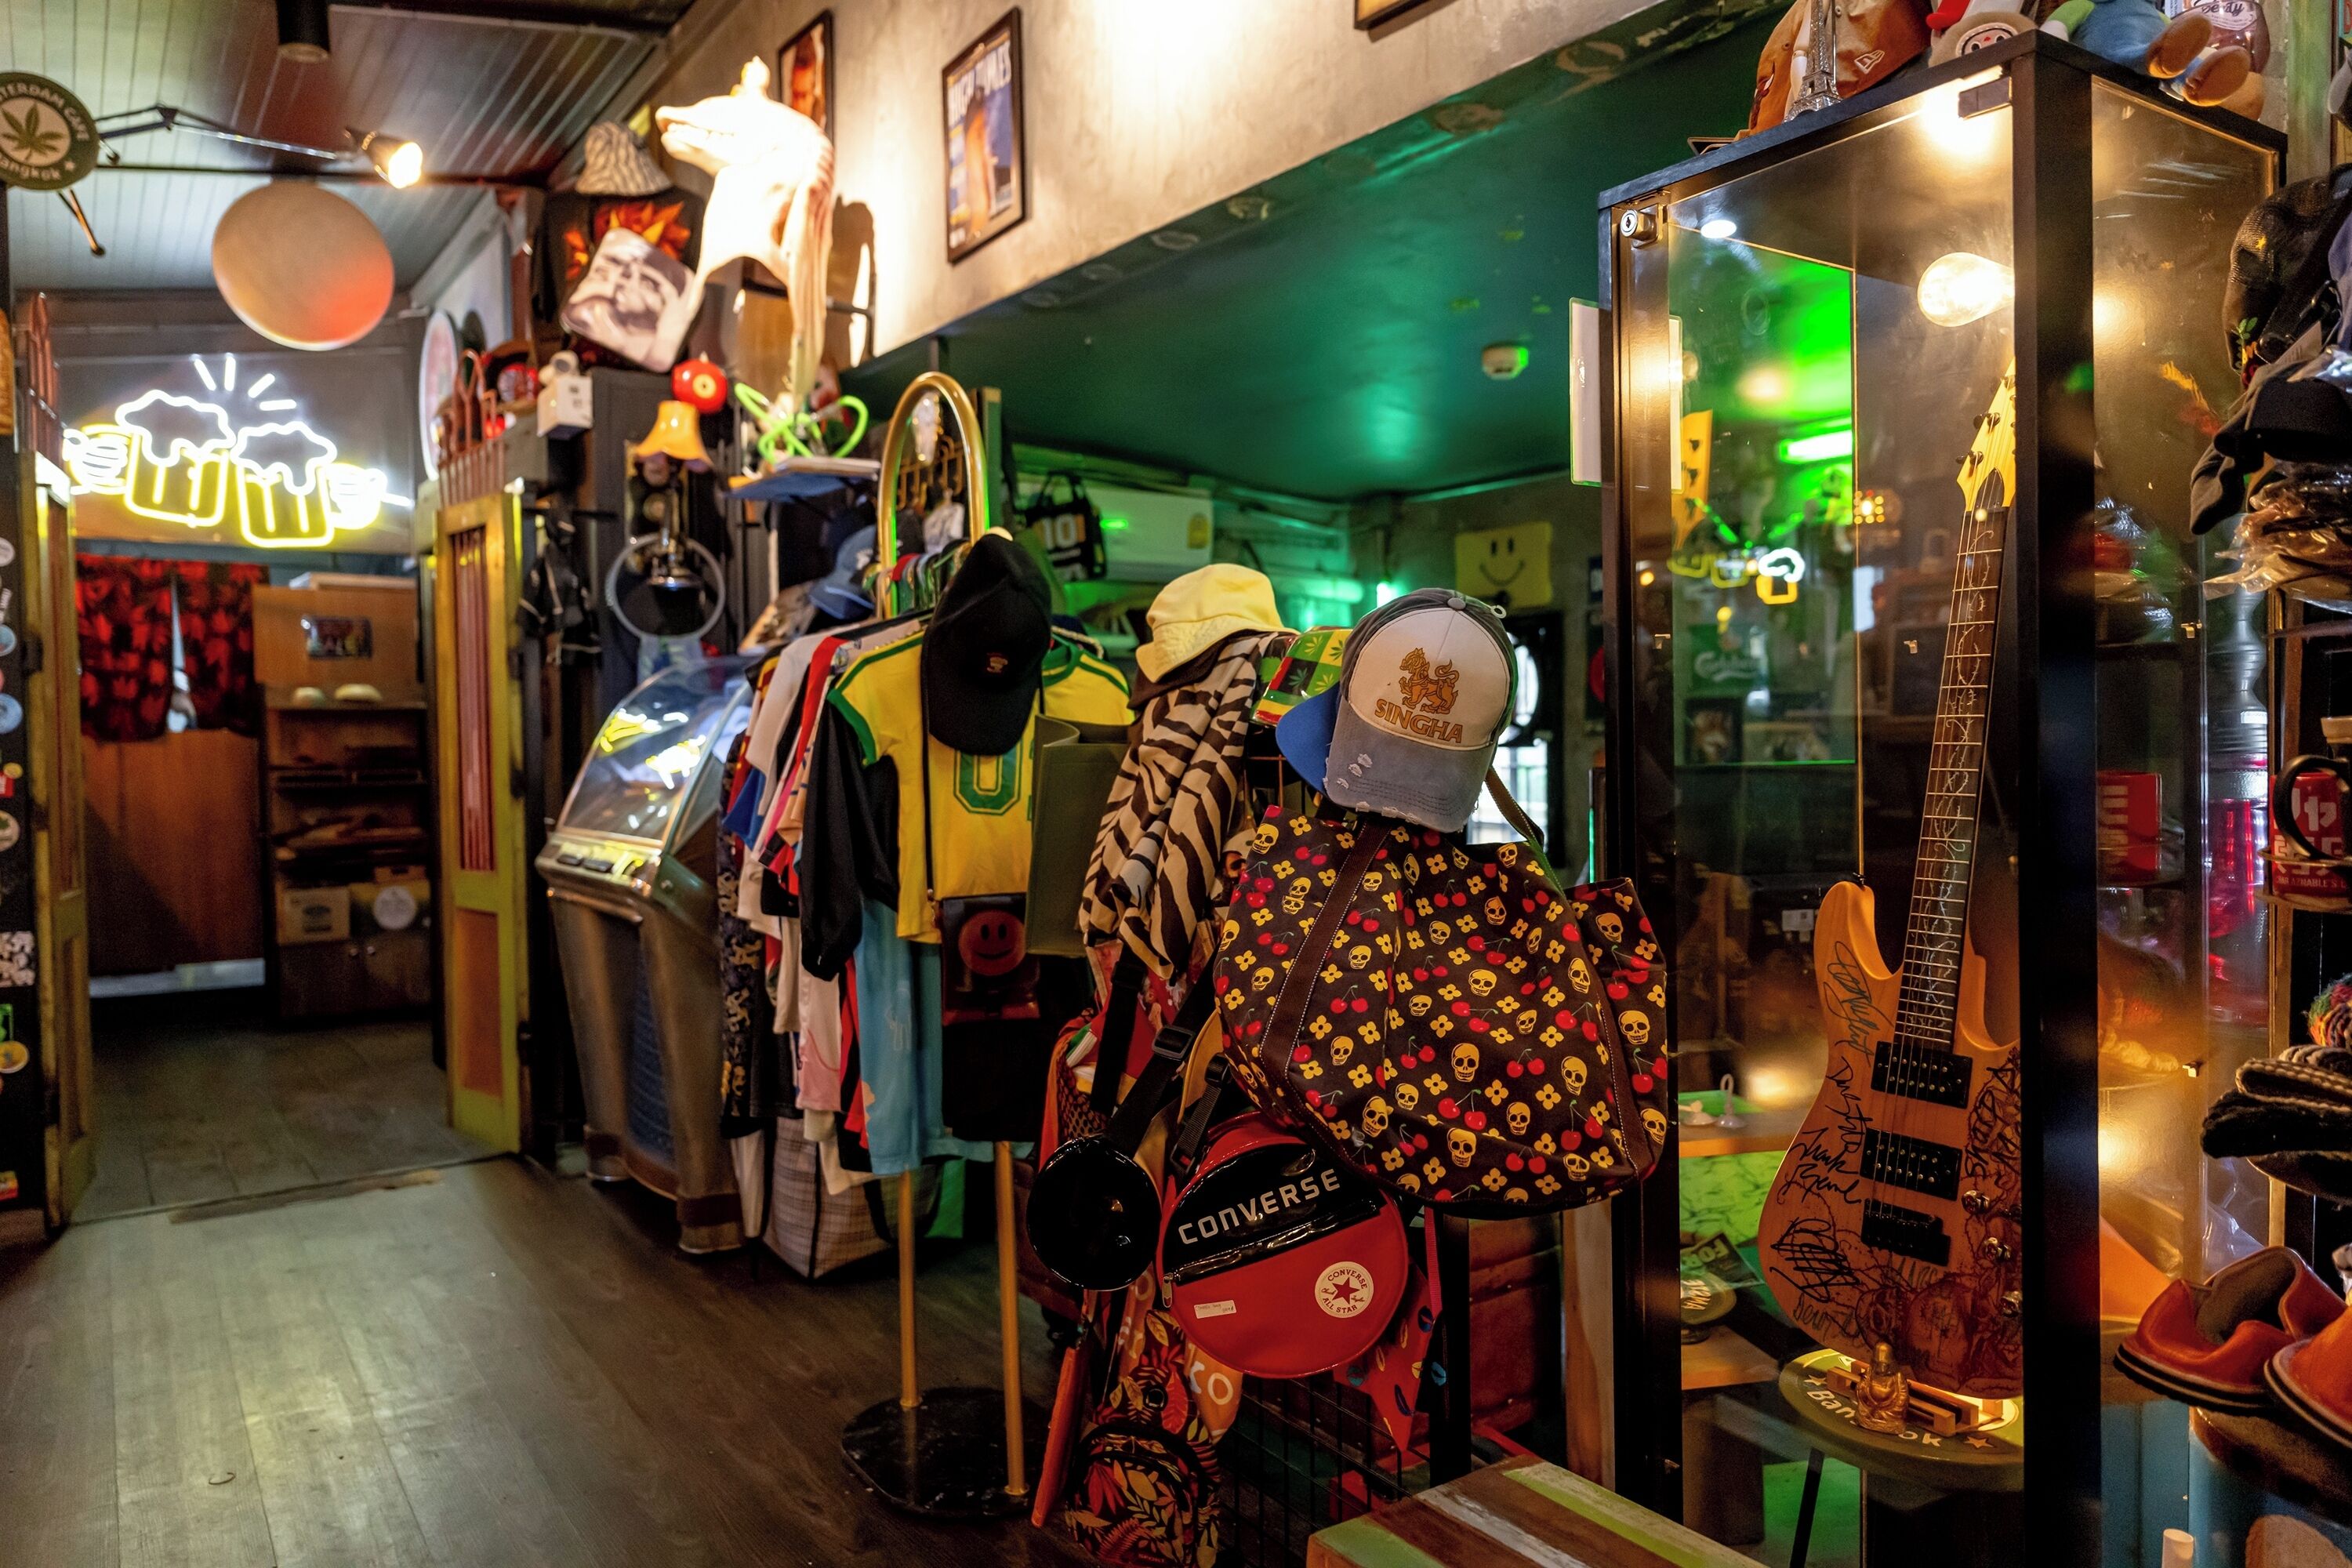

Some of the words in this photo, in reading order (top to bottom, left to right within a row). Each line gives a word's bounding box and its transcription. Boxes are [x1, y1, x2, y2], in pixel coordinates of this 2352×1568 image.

[0, 82, 64, 107] TERDAM
[0, 154, 61, 181] angkok
[1374, 698, 1463, 744] SINGHA
[1178, 1168, 1341, 1245] CONVERSE
[1327, 1269, 1367, 1289] CONVERSE
[1323, 1298, 1334, 1310] ALL
[1336, 1304, 1358, 1313] STAR
[1806, 1389, 1943, 1447] Banok
